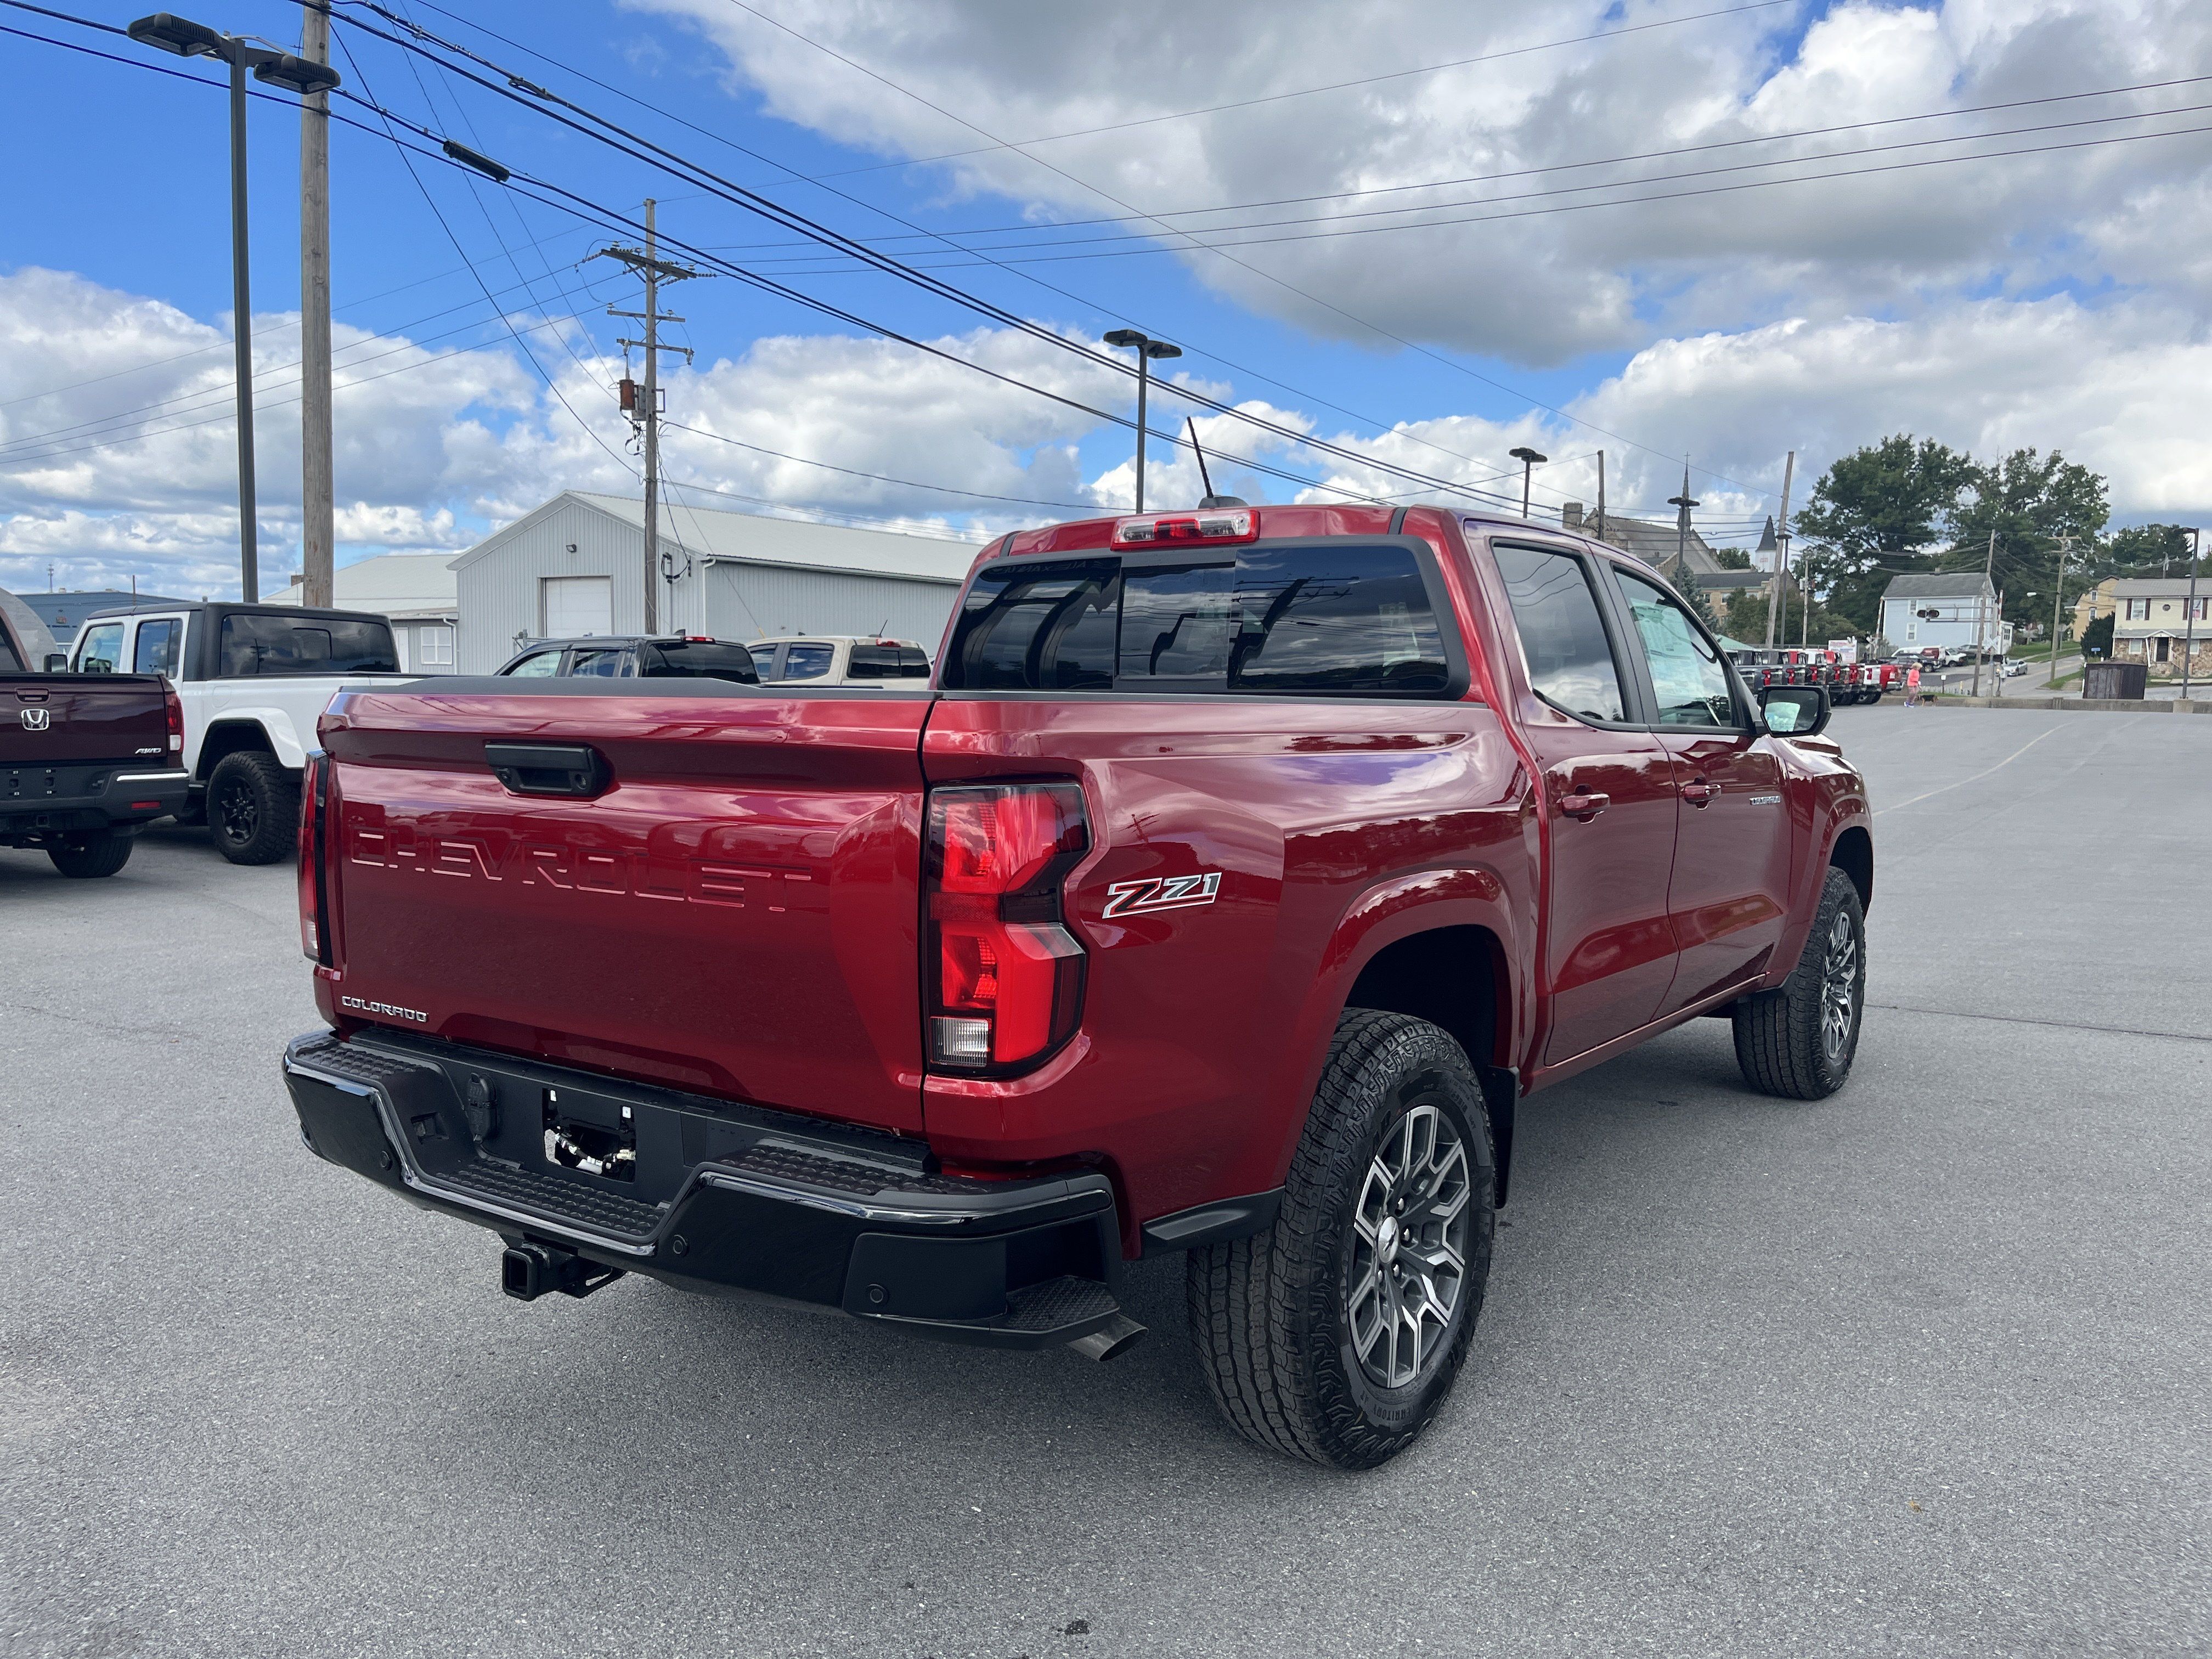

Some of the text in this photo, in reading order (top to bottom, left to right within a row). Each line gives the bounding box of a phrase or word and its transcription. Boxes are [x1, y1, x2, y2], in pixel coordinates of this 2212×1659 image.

[351, 825, 812, 912] CHEVROLET
[1102, 872, 1223, 919] Z71
[341, 995, 427, 1023] COLORADO
[1448, 1181, 1491, 1371] WRANGLER
[1372, 1402, 1415, 1423] TERRITORY
